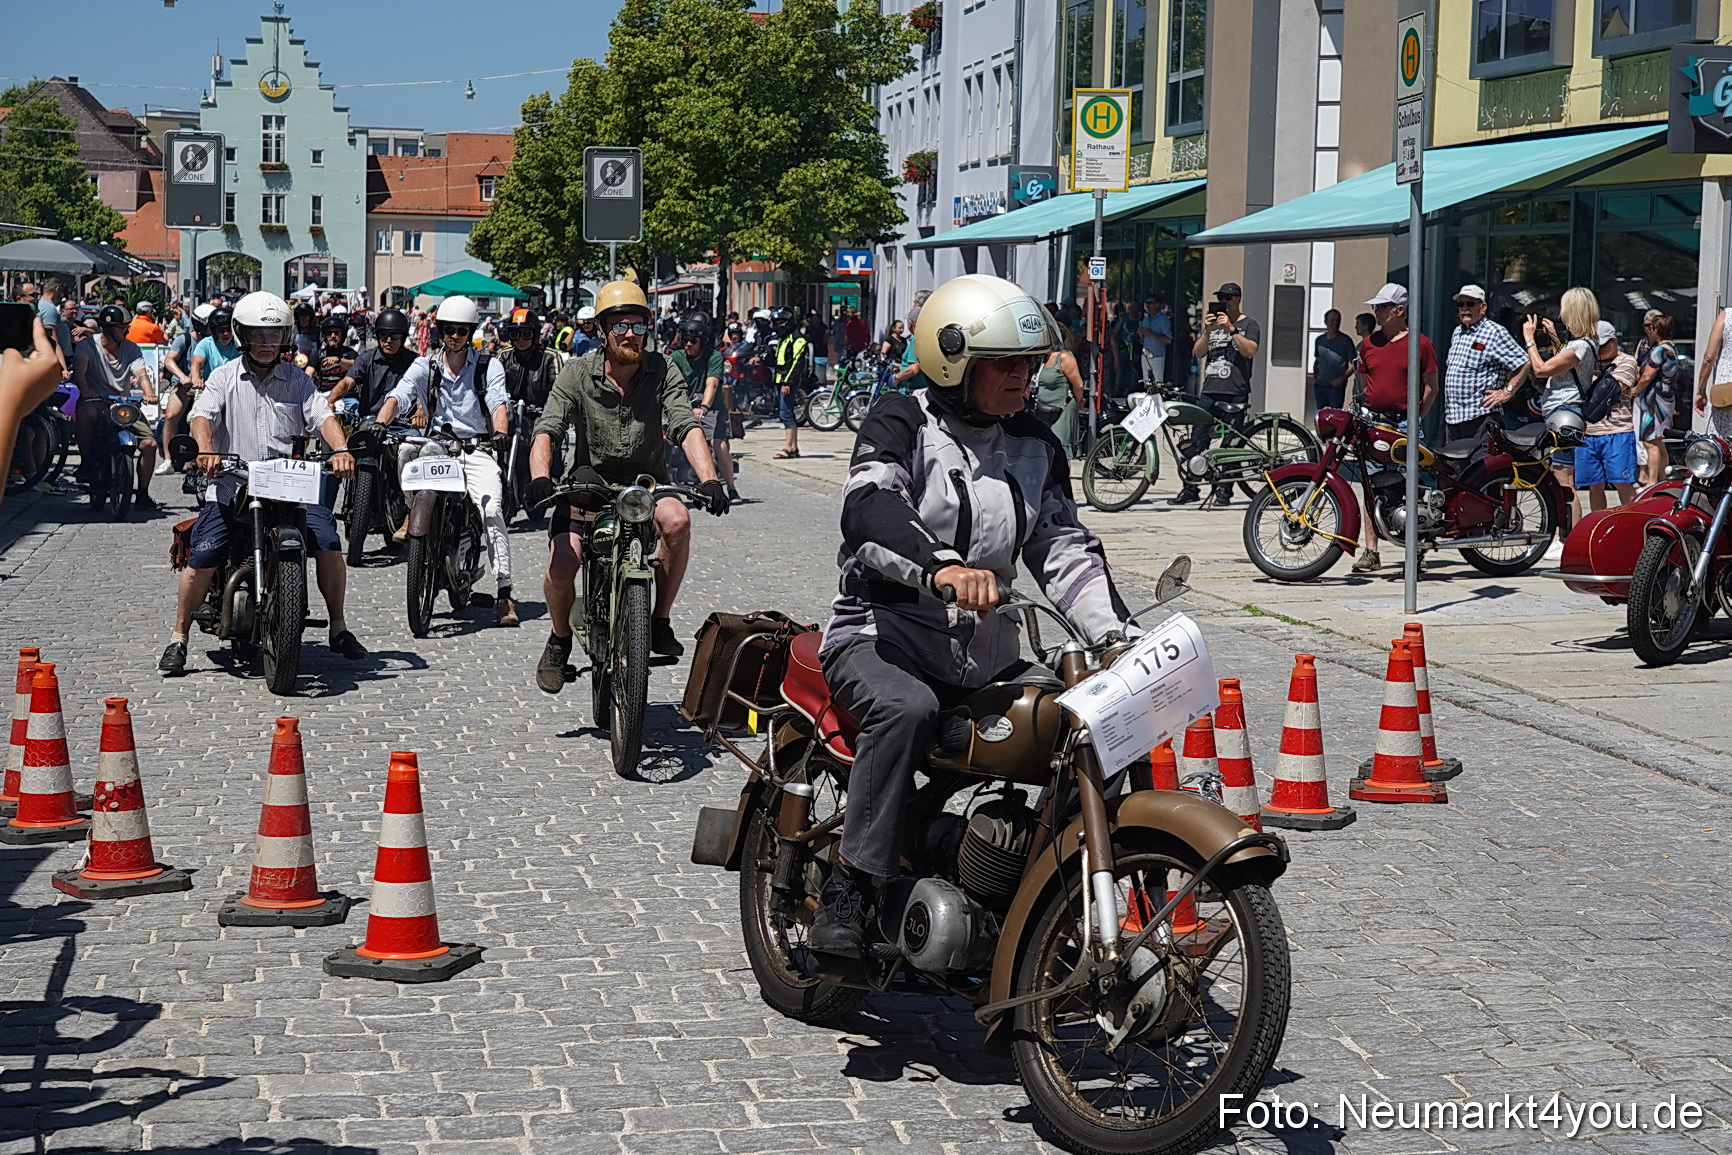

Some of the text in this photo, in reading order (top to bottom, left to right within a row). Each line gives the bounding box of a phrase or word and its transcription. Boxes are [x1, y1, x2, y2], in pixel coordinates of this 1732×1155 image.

[1093, 105, 1111, 129] H
[1398, 108, 1421, 129] Schulbus
[1086, 143, 1116, 151] Rathaus
[183, 173, 205, 181] ZONE
[603, 188, 624, 196] ZONE
[1026, 179, 1044, 200] G2
[283, 460, 307, 471] 174
[430, 464, 451, 475] 607
[1133, 638, 1180, 676] 175
